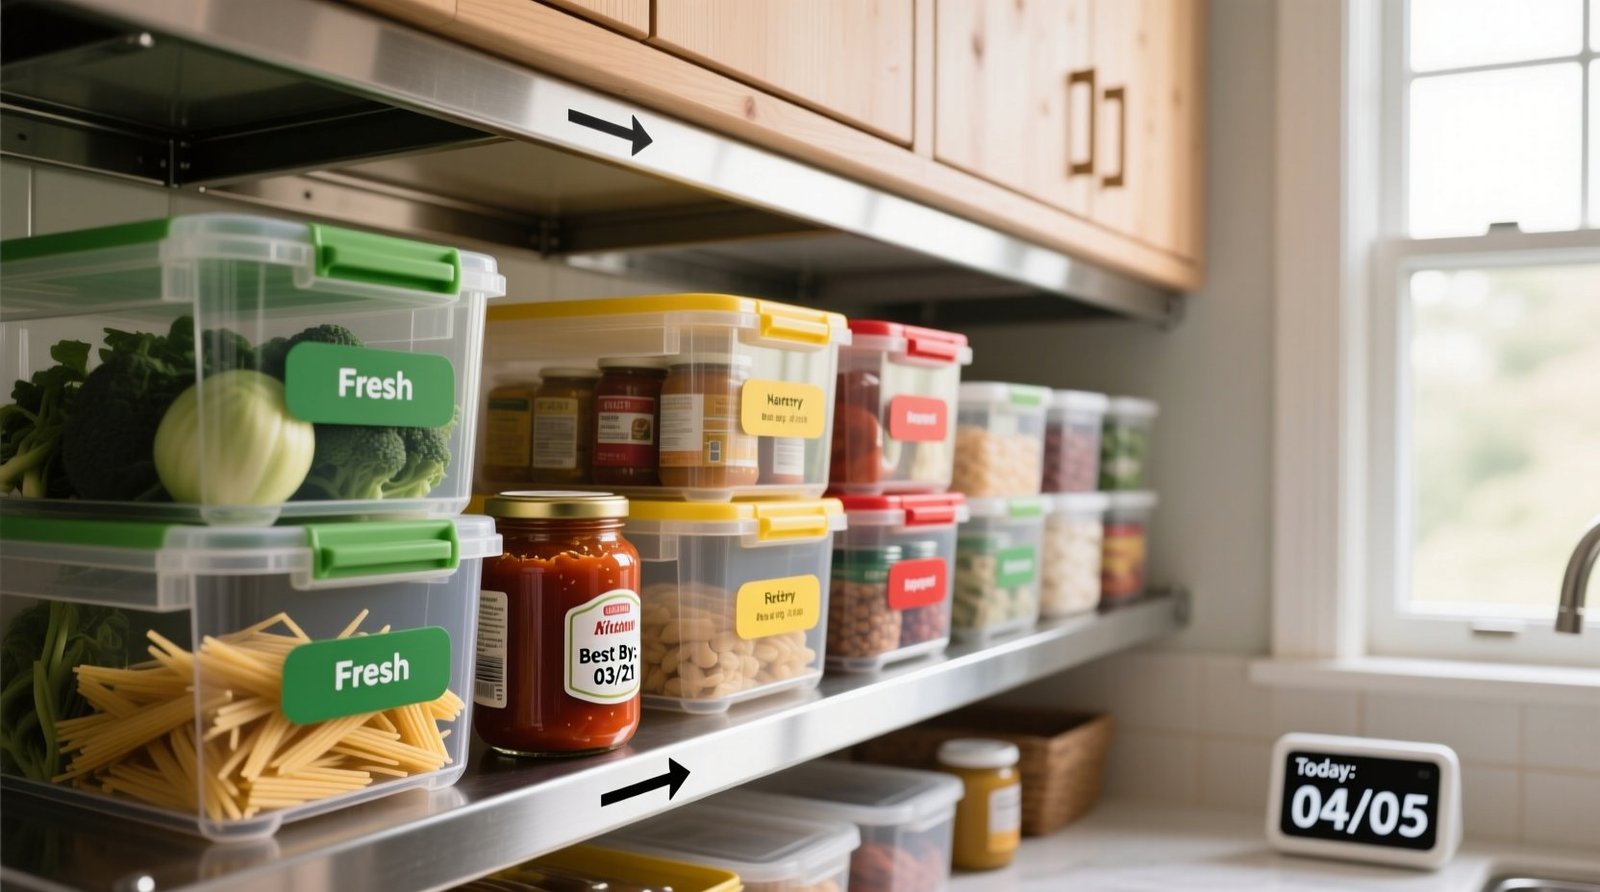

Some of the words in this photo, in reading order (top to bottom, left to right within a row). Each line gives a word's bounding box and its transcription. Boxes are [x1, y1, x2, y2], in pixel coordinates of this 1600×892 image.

[338, 367, 413, 401] Fresh
[579, 647, 615, 664] Best
[619, 644, 637, 662] By:
[335, 652, 410, 691] Fresh
[593, 664, 634, 686] 03/21
[1295, 757, 1357, 783] Today:
[1291, 784, 1429, 838] 04/05
